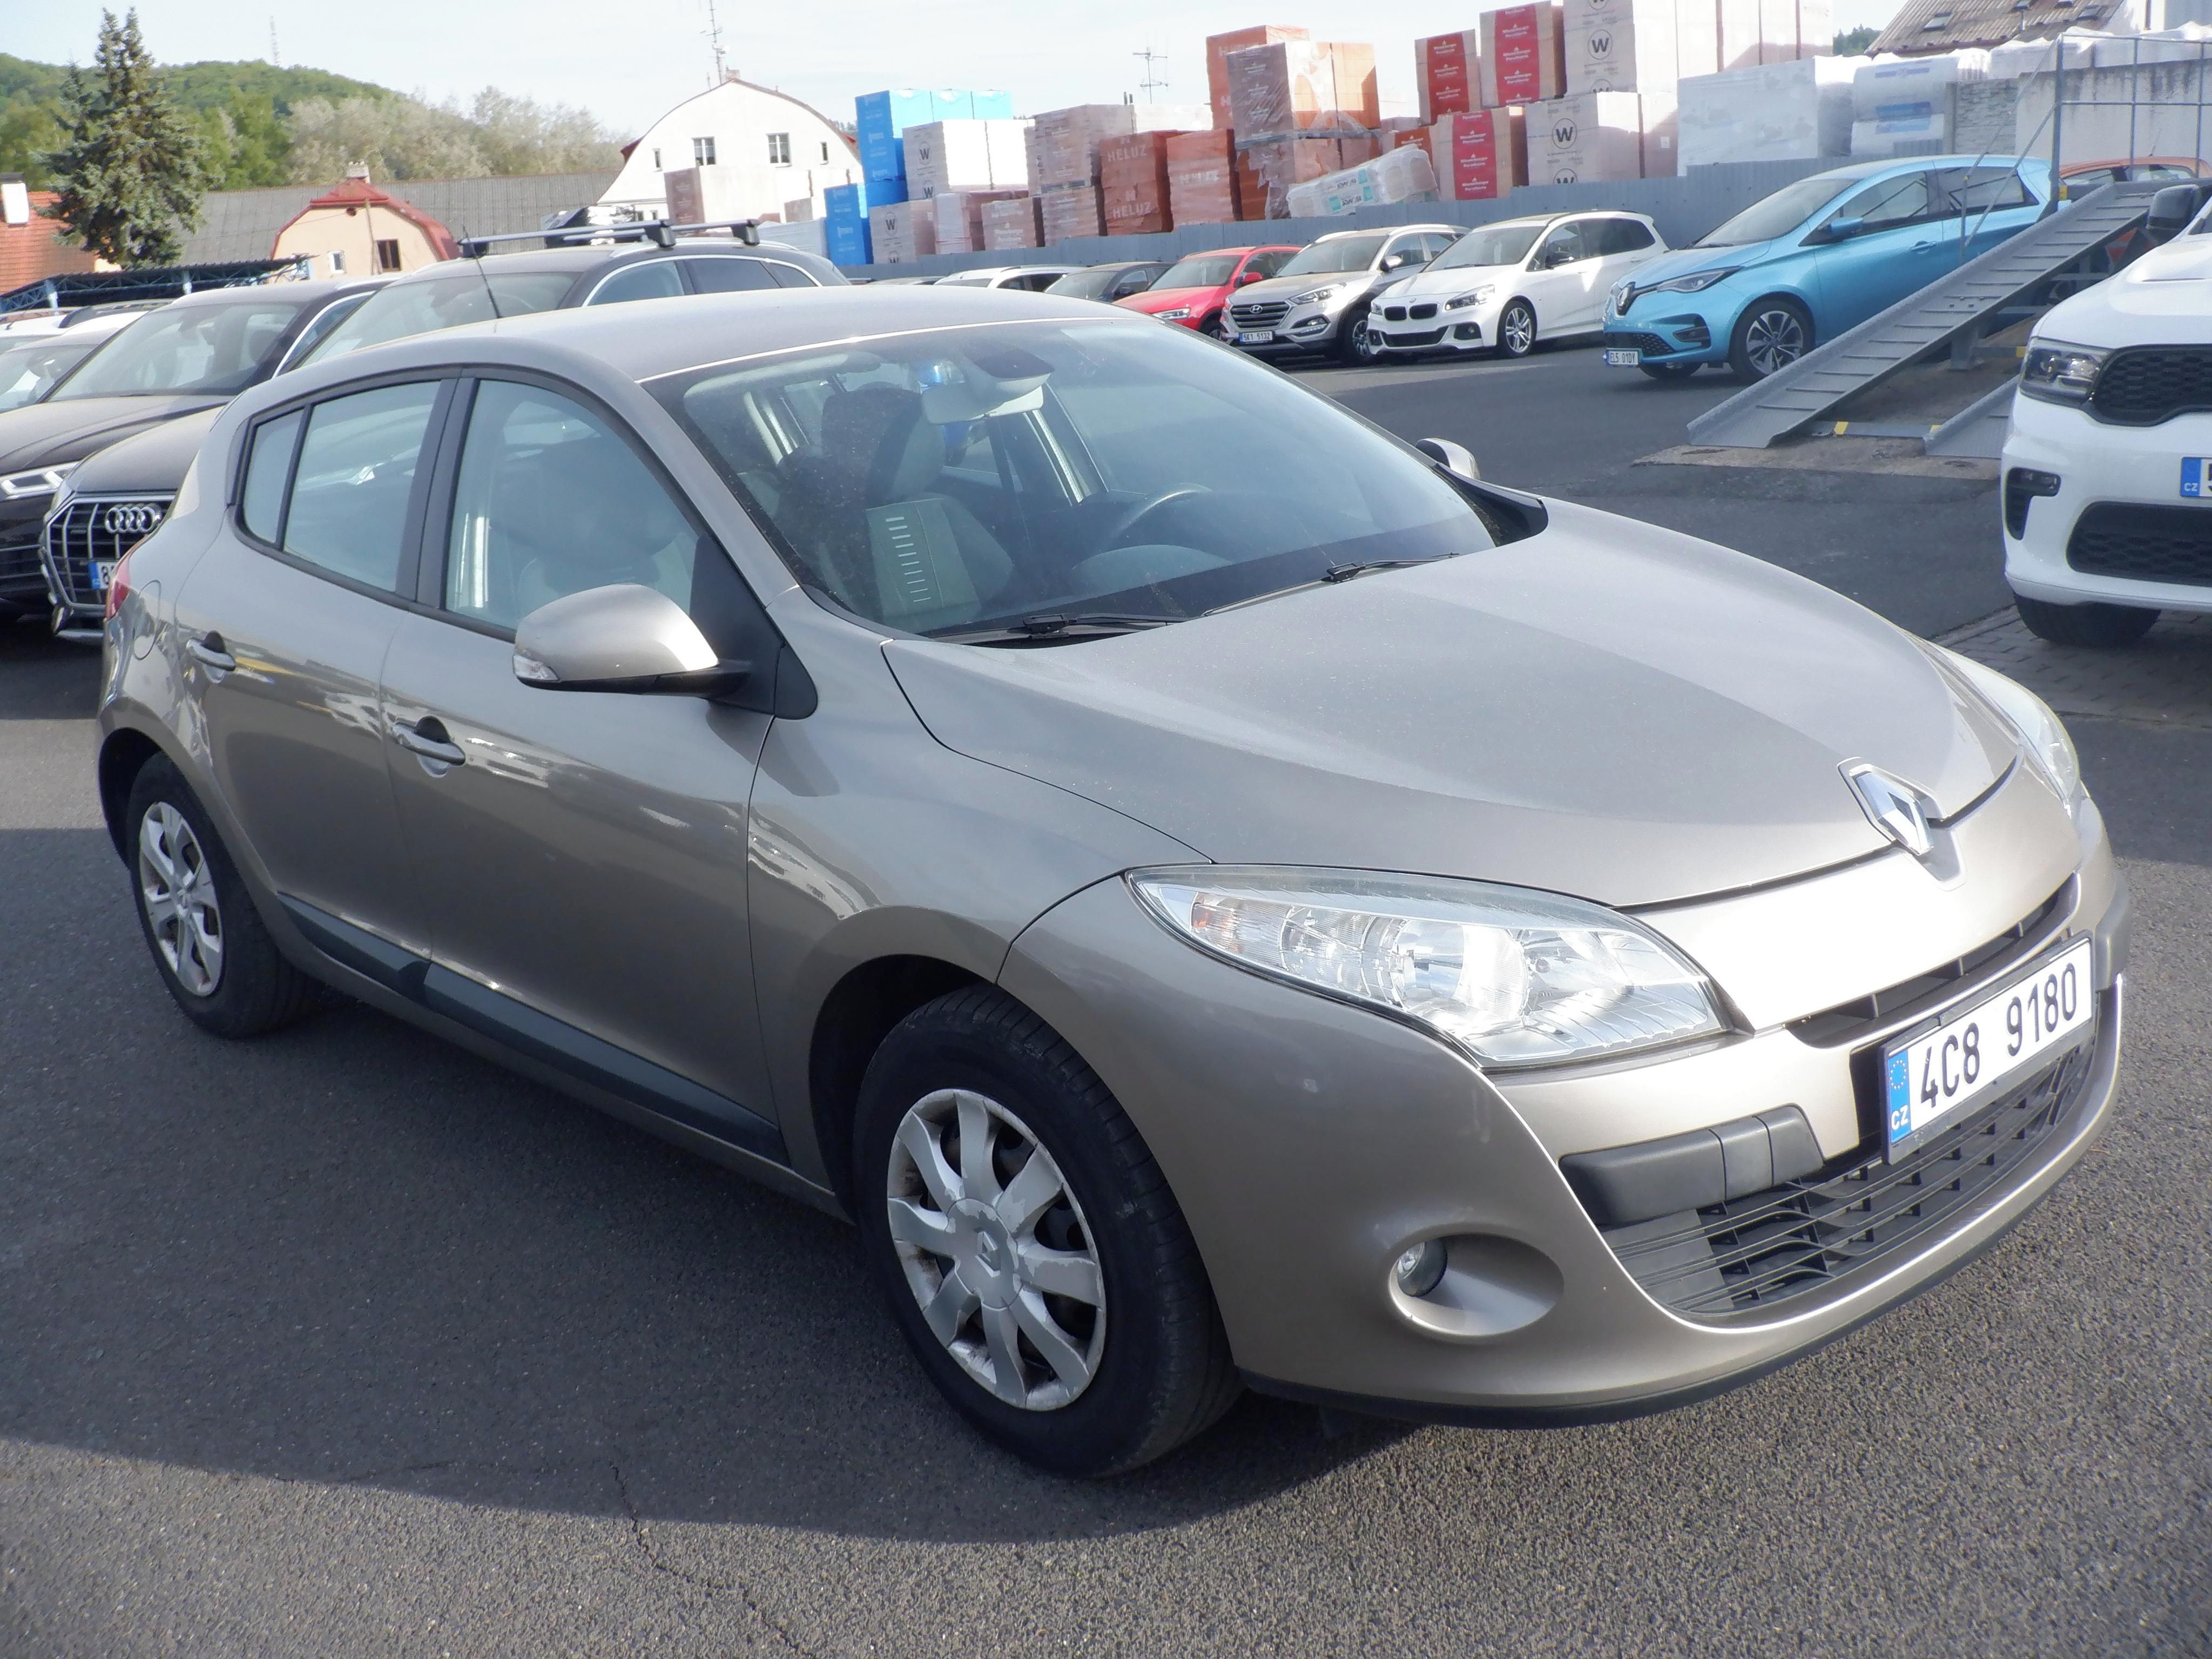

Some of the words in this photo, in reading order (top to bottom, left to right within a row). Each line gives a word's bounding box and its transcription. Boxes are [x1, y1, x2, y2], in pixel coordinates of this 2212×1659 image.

[1591, 38, 1609, 53] W
[1555, 126, 1573, 143] W
[920, 148, 929, 160] W
[1107, 145, 1147, 161] HELUZ
[1112, 201, 1151, 219] HELUZ
[885, 219, 895, 231] W
[2184, 482, 2198, 491] CZ
[1891, 1104, 1909, 1131] CZ
[1920, 1022, 1980, 1108] 4C8
[2006, 962, 2076, 1057] 9180
